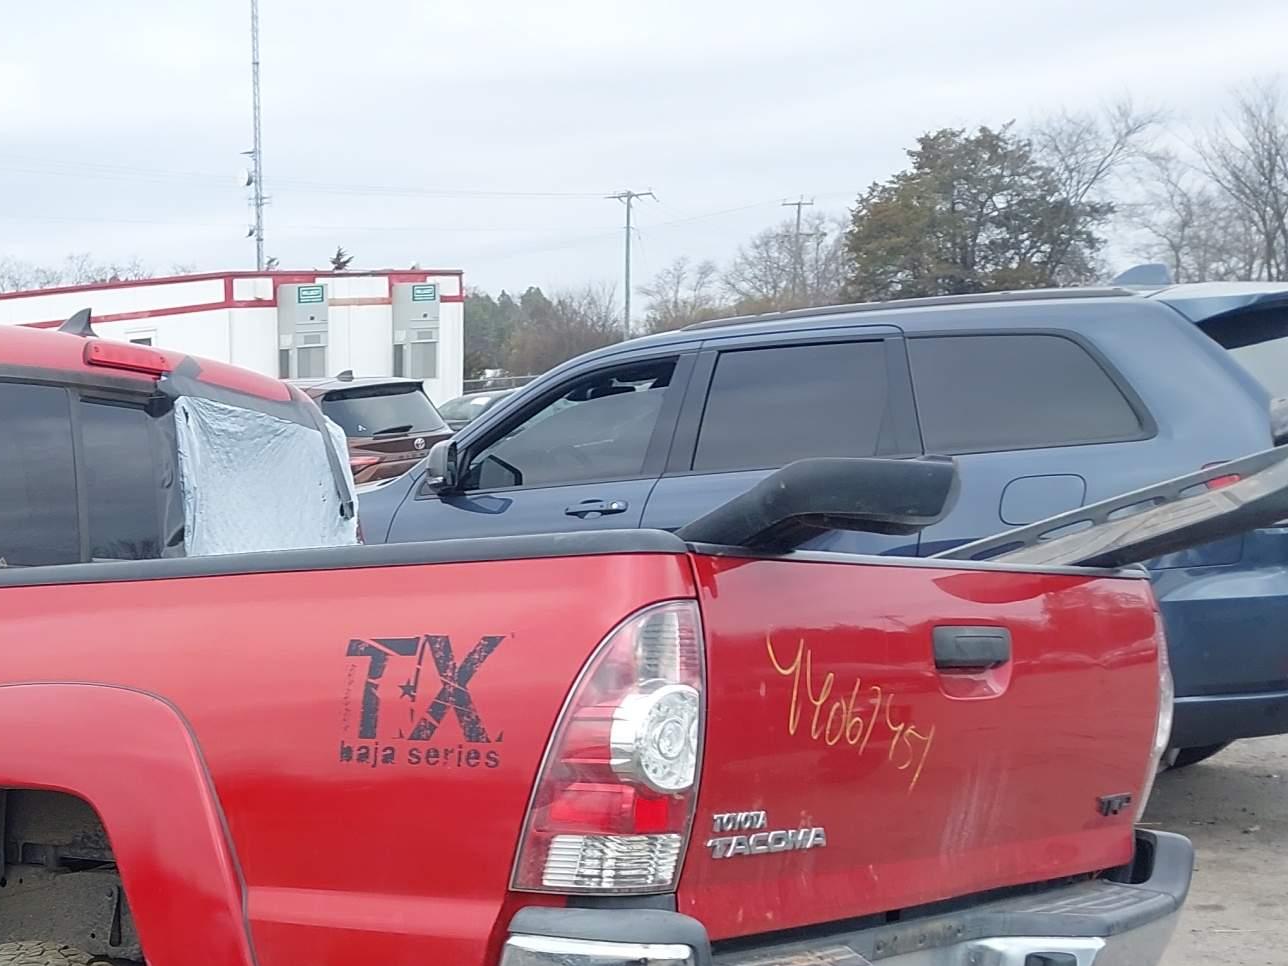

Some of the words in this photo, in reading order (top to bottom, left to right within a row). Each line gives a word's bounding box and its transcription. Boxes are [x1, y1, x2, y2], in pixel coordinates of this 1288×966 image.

[346, 634, 507, 744] TX
[339, 740, 396, 768] baja
[407, 743, 500, 768] series
[712, 810, 768, 833] TOYOTA
[705, 826, 827, 860] TACOMA
